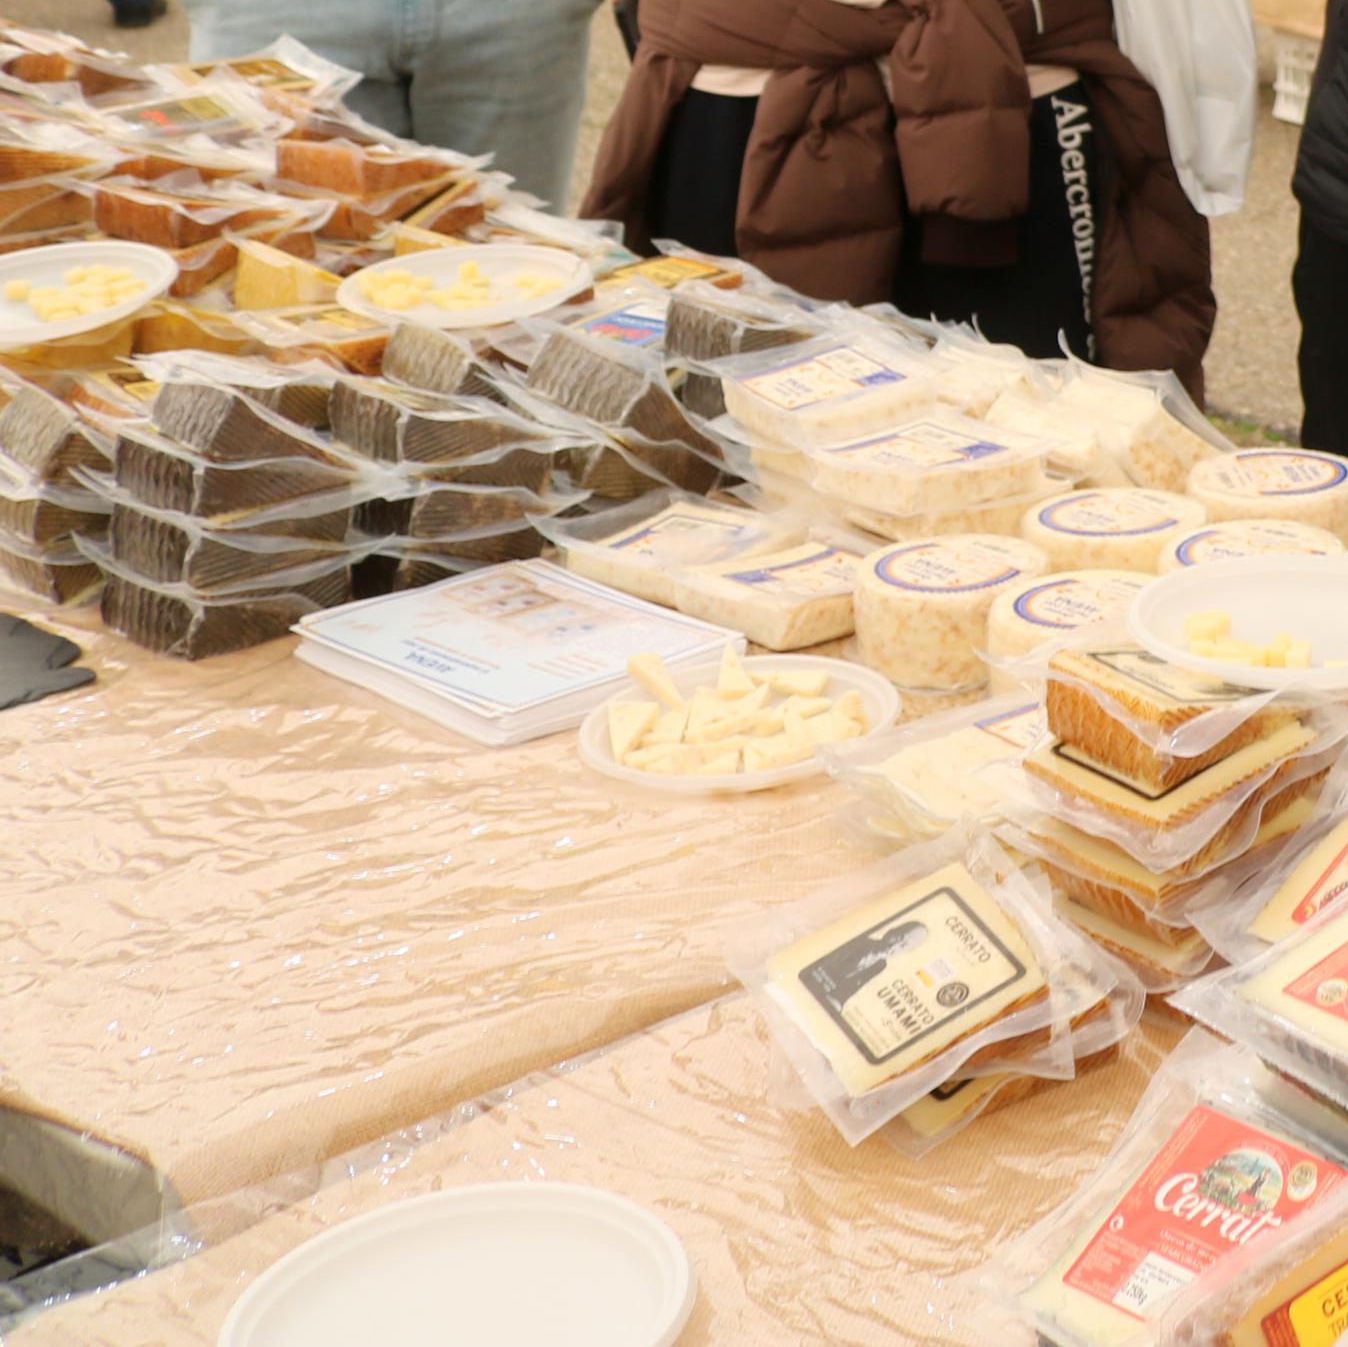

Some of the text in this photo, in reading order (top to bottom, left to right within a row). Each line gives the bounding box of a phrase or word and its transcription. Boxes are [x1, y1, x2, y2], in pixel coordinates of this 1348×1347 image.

[945, 916, 991, 963] CERRATO
[877, 986, 922, 1035] UMAMI
[892, 979, 934, 1024] CERRATO
[1155, 1173, 1282, 1245] Cerrat
